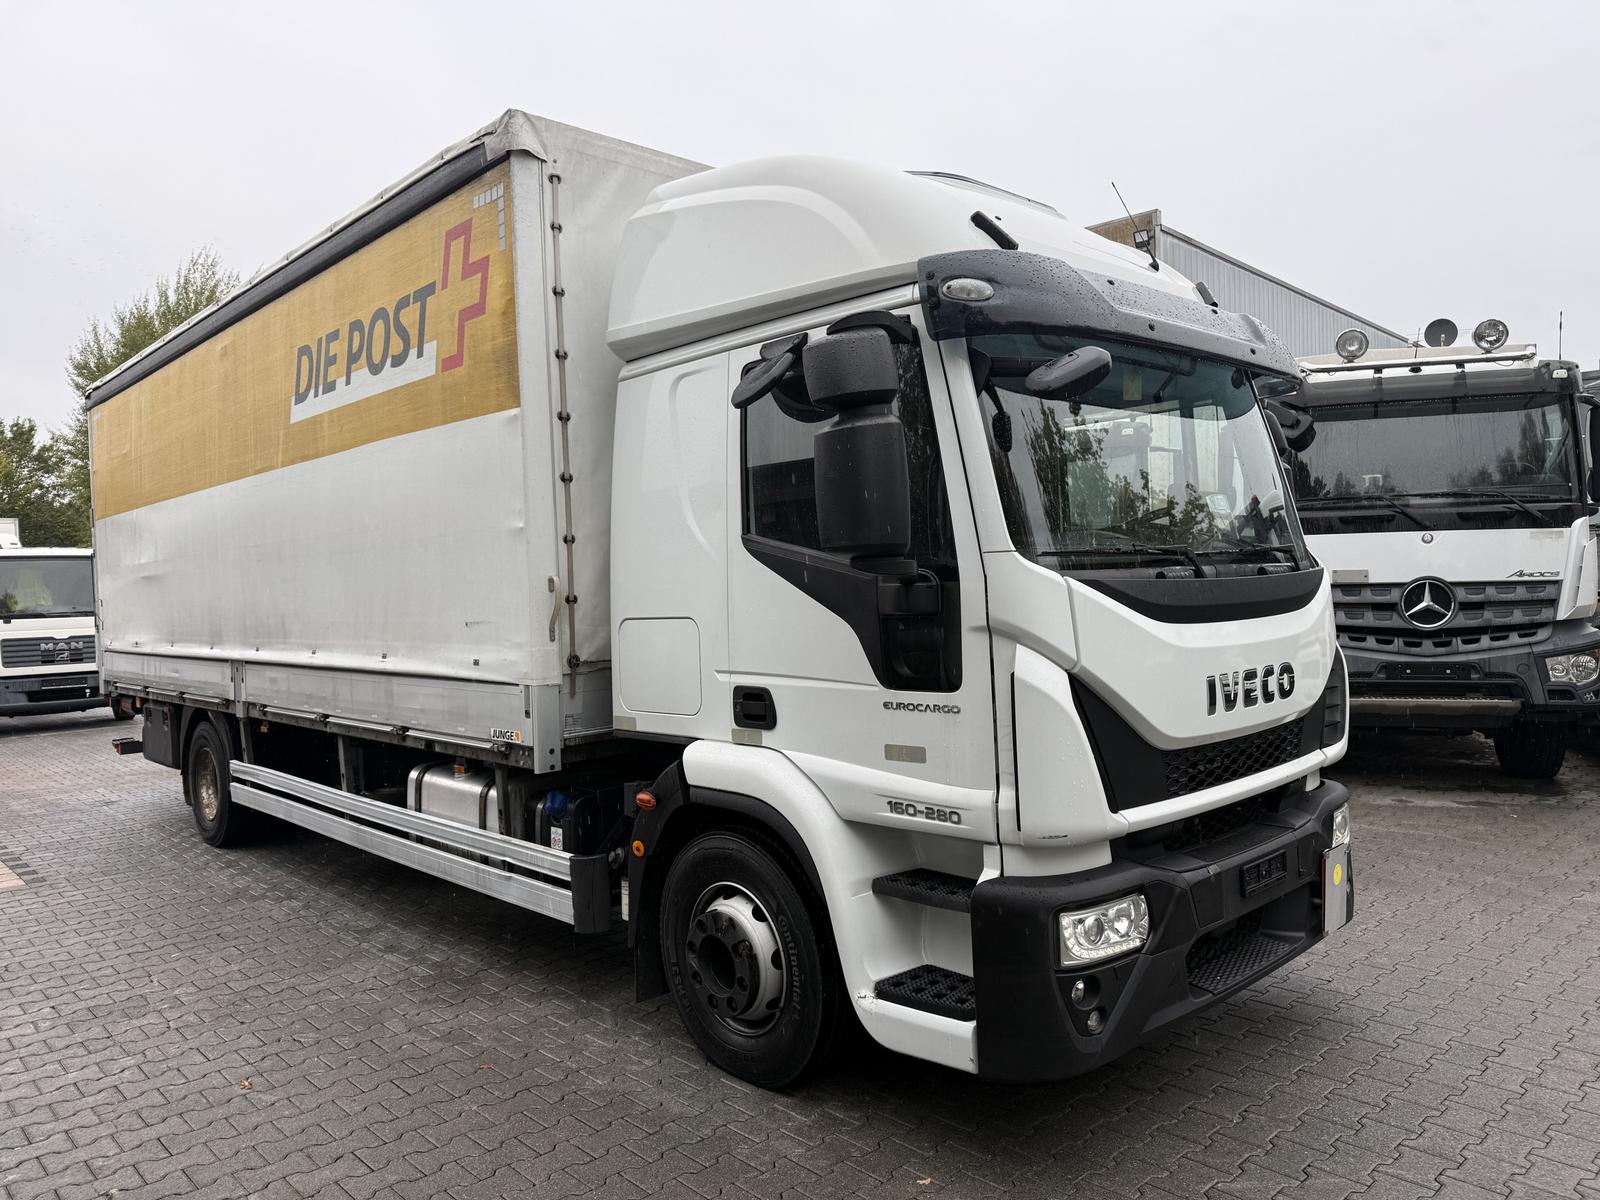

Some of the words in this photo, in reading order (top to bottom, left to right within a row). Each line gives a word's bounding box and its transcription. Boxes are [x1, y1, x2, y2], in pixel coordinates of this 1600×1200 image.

[294, 328, 340, 406] DIE
[345, 280, 436, 386] POST
[40, 641, 83, 651] MAN
[1206, 661, 1295, 717] IVECO
[883, 701, 961, 714] EUROCARGO
[492, 728, 514, 741] JUNGE
[887, 800, 961, 825] 160-280
